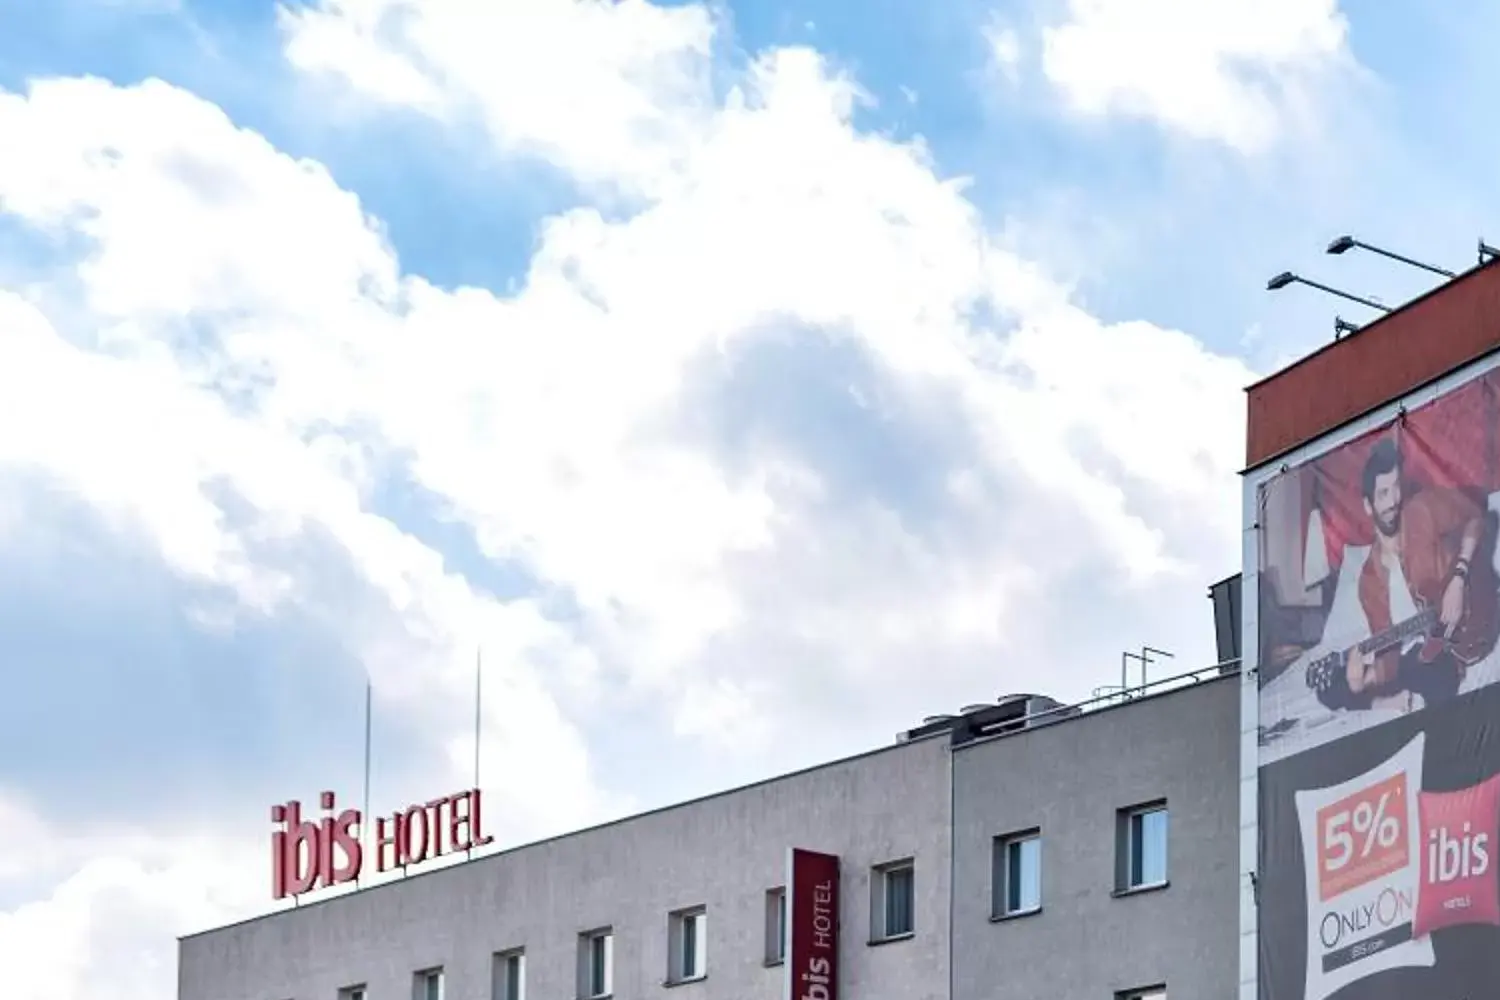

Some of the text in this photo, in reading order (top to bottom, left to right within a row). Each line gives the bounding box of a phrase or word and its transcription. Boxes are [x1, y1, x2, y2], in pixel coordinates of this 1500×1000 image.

[271, 788, 495, 900] ibis HOTEL
[1428, 821, 1489, 884] ibis
[813, 879, 833, 948] HOTEL
